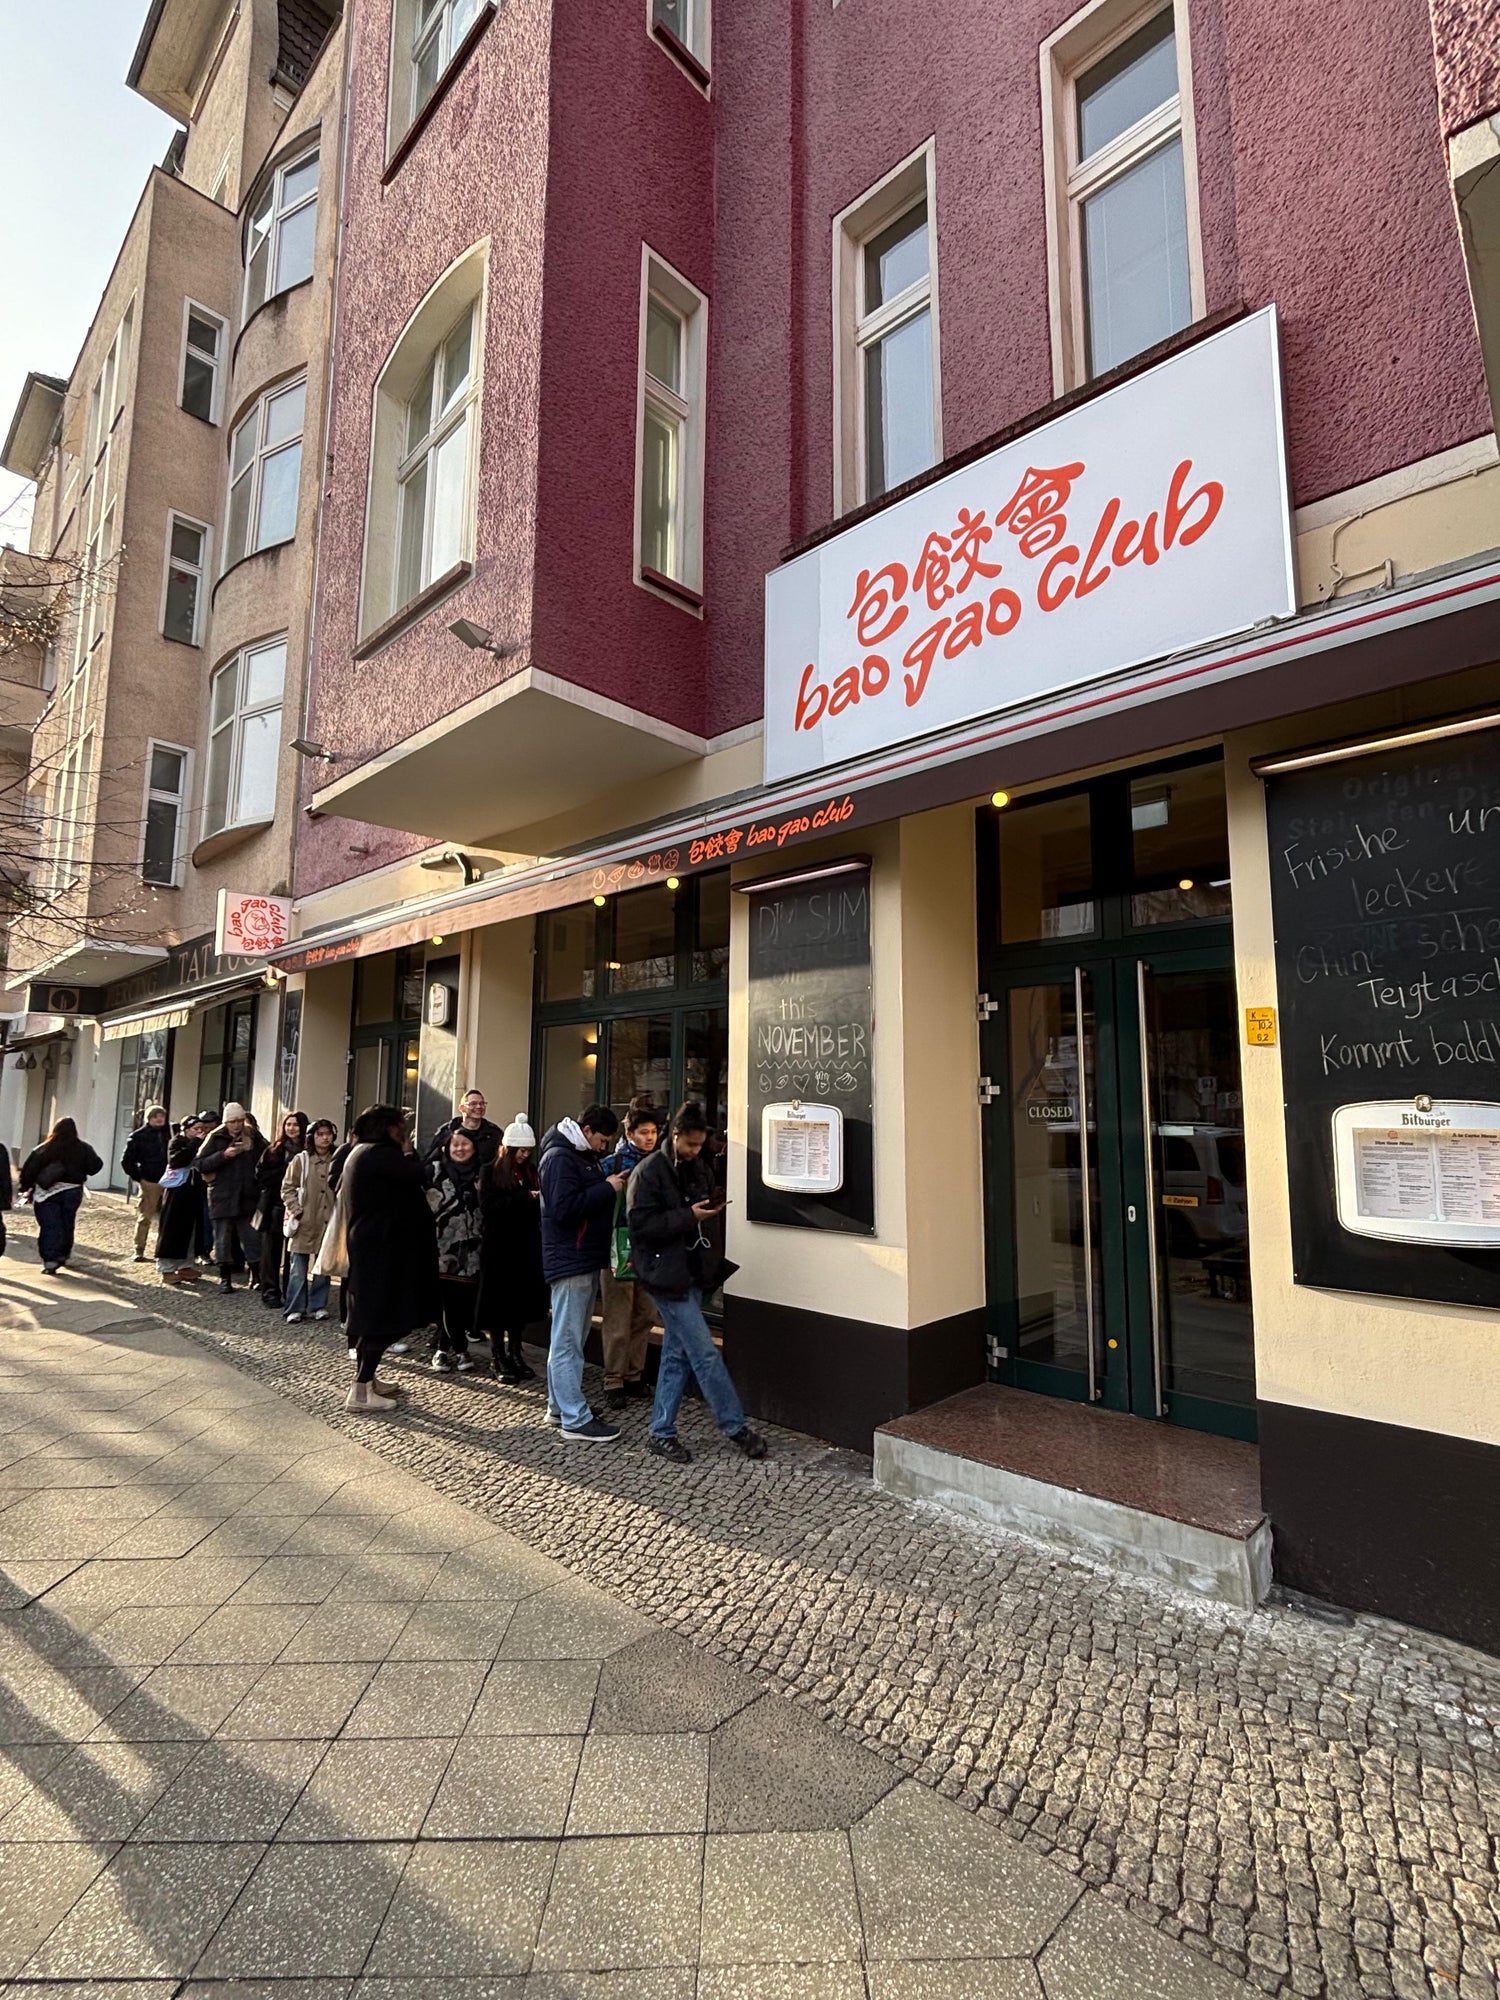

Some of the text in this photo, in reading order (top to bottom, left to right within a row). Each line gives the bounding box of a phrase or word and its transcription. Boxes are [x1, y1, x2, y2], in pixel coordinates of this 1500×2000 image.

[794, 459, 1224, 732] bao gao club
[747, 795, 855, 847] bao gao club
[1283, 824, 1410, 889] Frische
[227, 911, 243, 937] bao
[240, 899, 267, 914] gao
[806, 887, 867, 941] SUM
[779, 994, 818, 1021] this
[757, 1023, 867, 1058] NOVEMBER
[1320, 1029, 1420, 1076] Kommt
[1028, 1106, 1073, 1118] CLOSED
[1401, 1113, 1452, 1128] Bitburger
